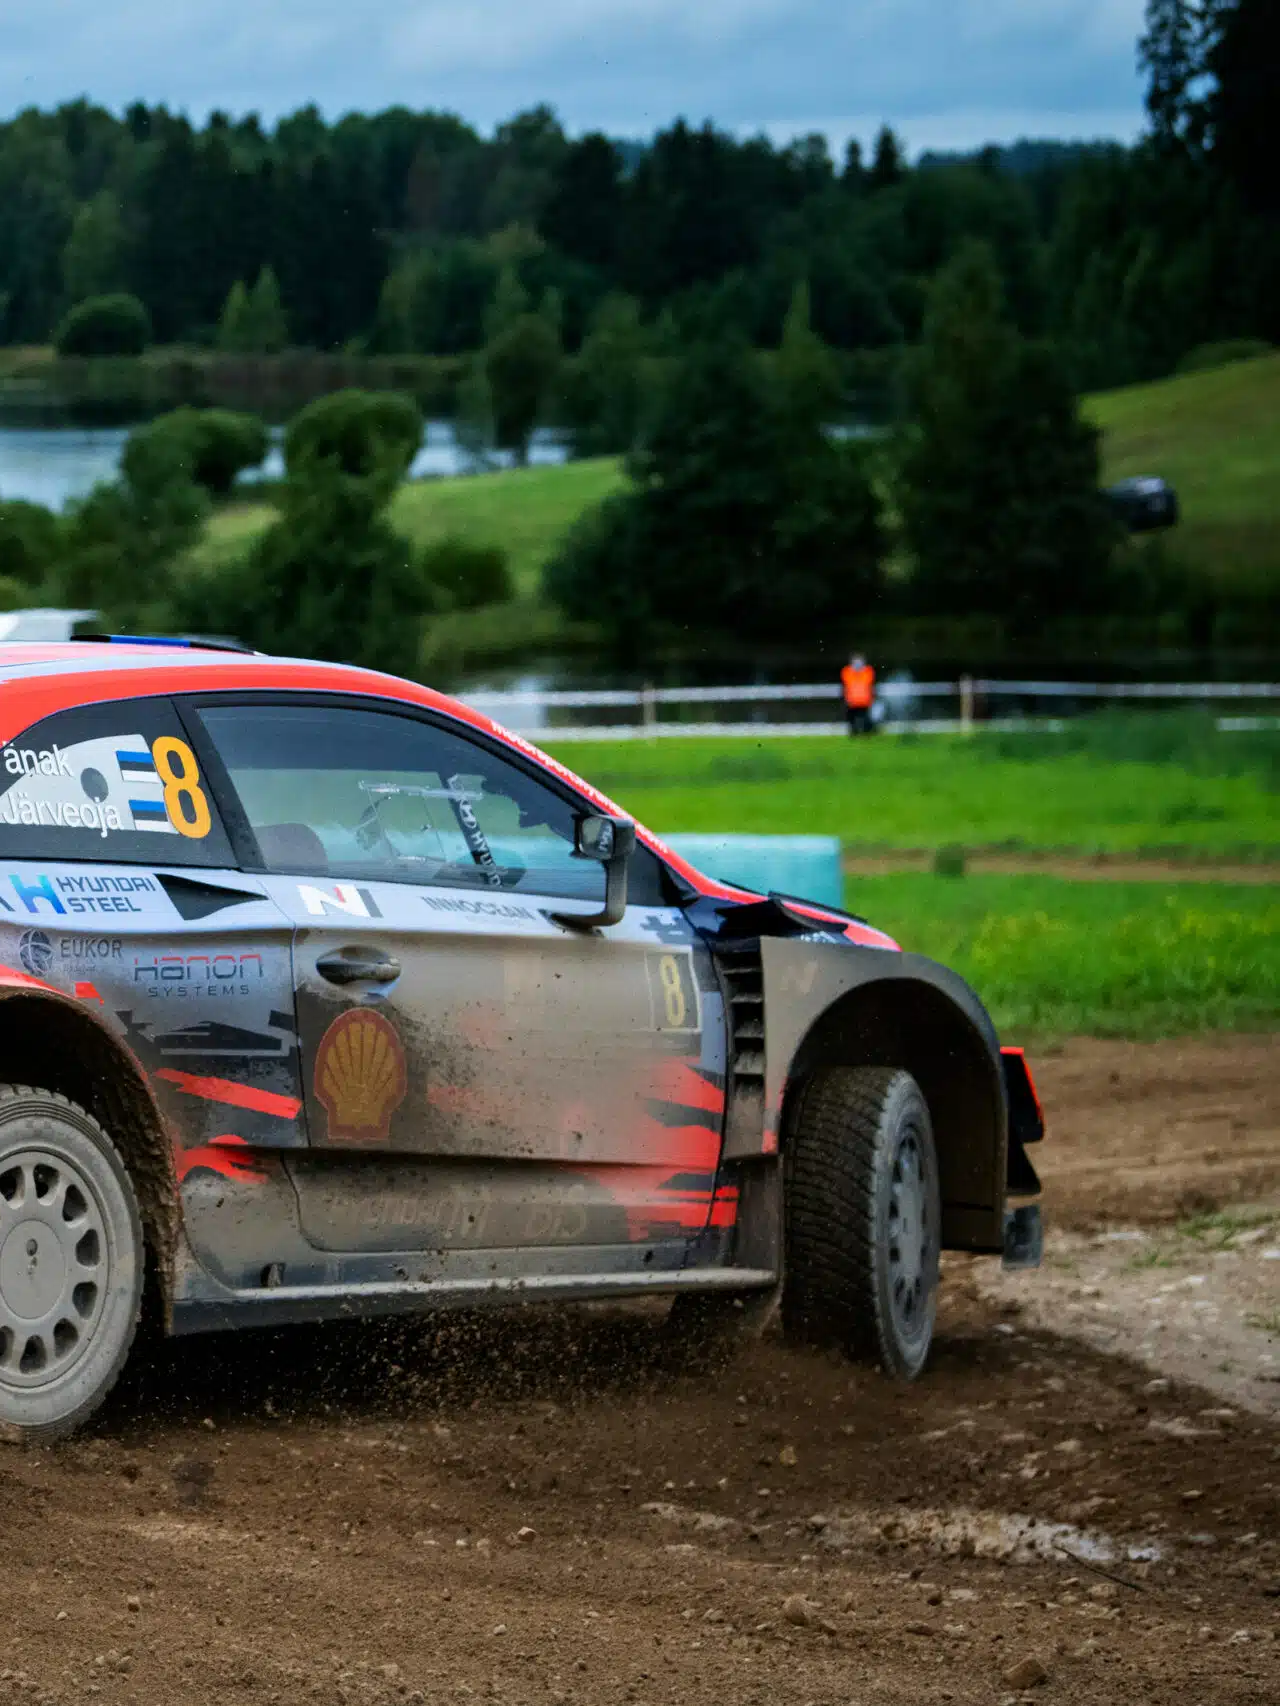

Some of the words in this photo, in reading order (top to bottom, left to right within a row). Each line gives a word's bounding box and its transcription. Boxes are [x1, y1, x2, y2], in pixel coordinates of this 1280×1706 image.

[152, 736, 211, 838] 8
[1, 791, 124, 838] Järveoja
[56, 876, 156, 892] HYUNDAI
[67, 897, 142, 913] STEEL
[61, 938, 122, 958] EUKOR
[148, 985, 250, 998] SYSTEMS
[660, 954, 685, 1026] 8
